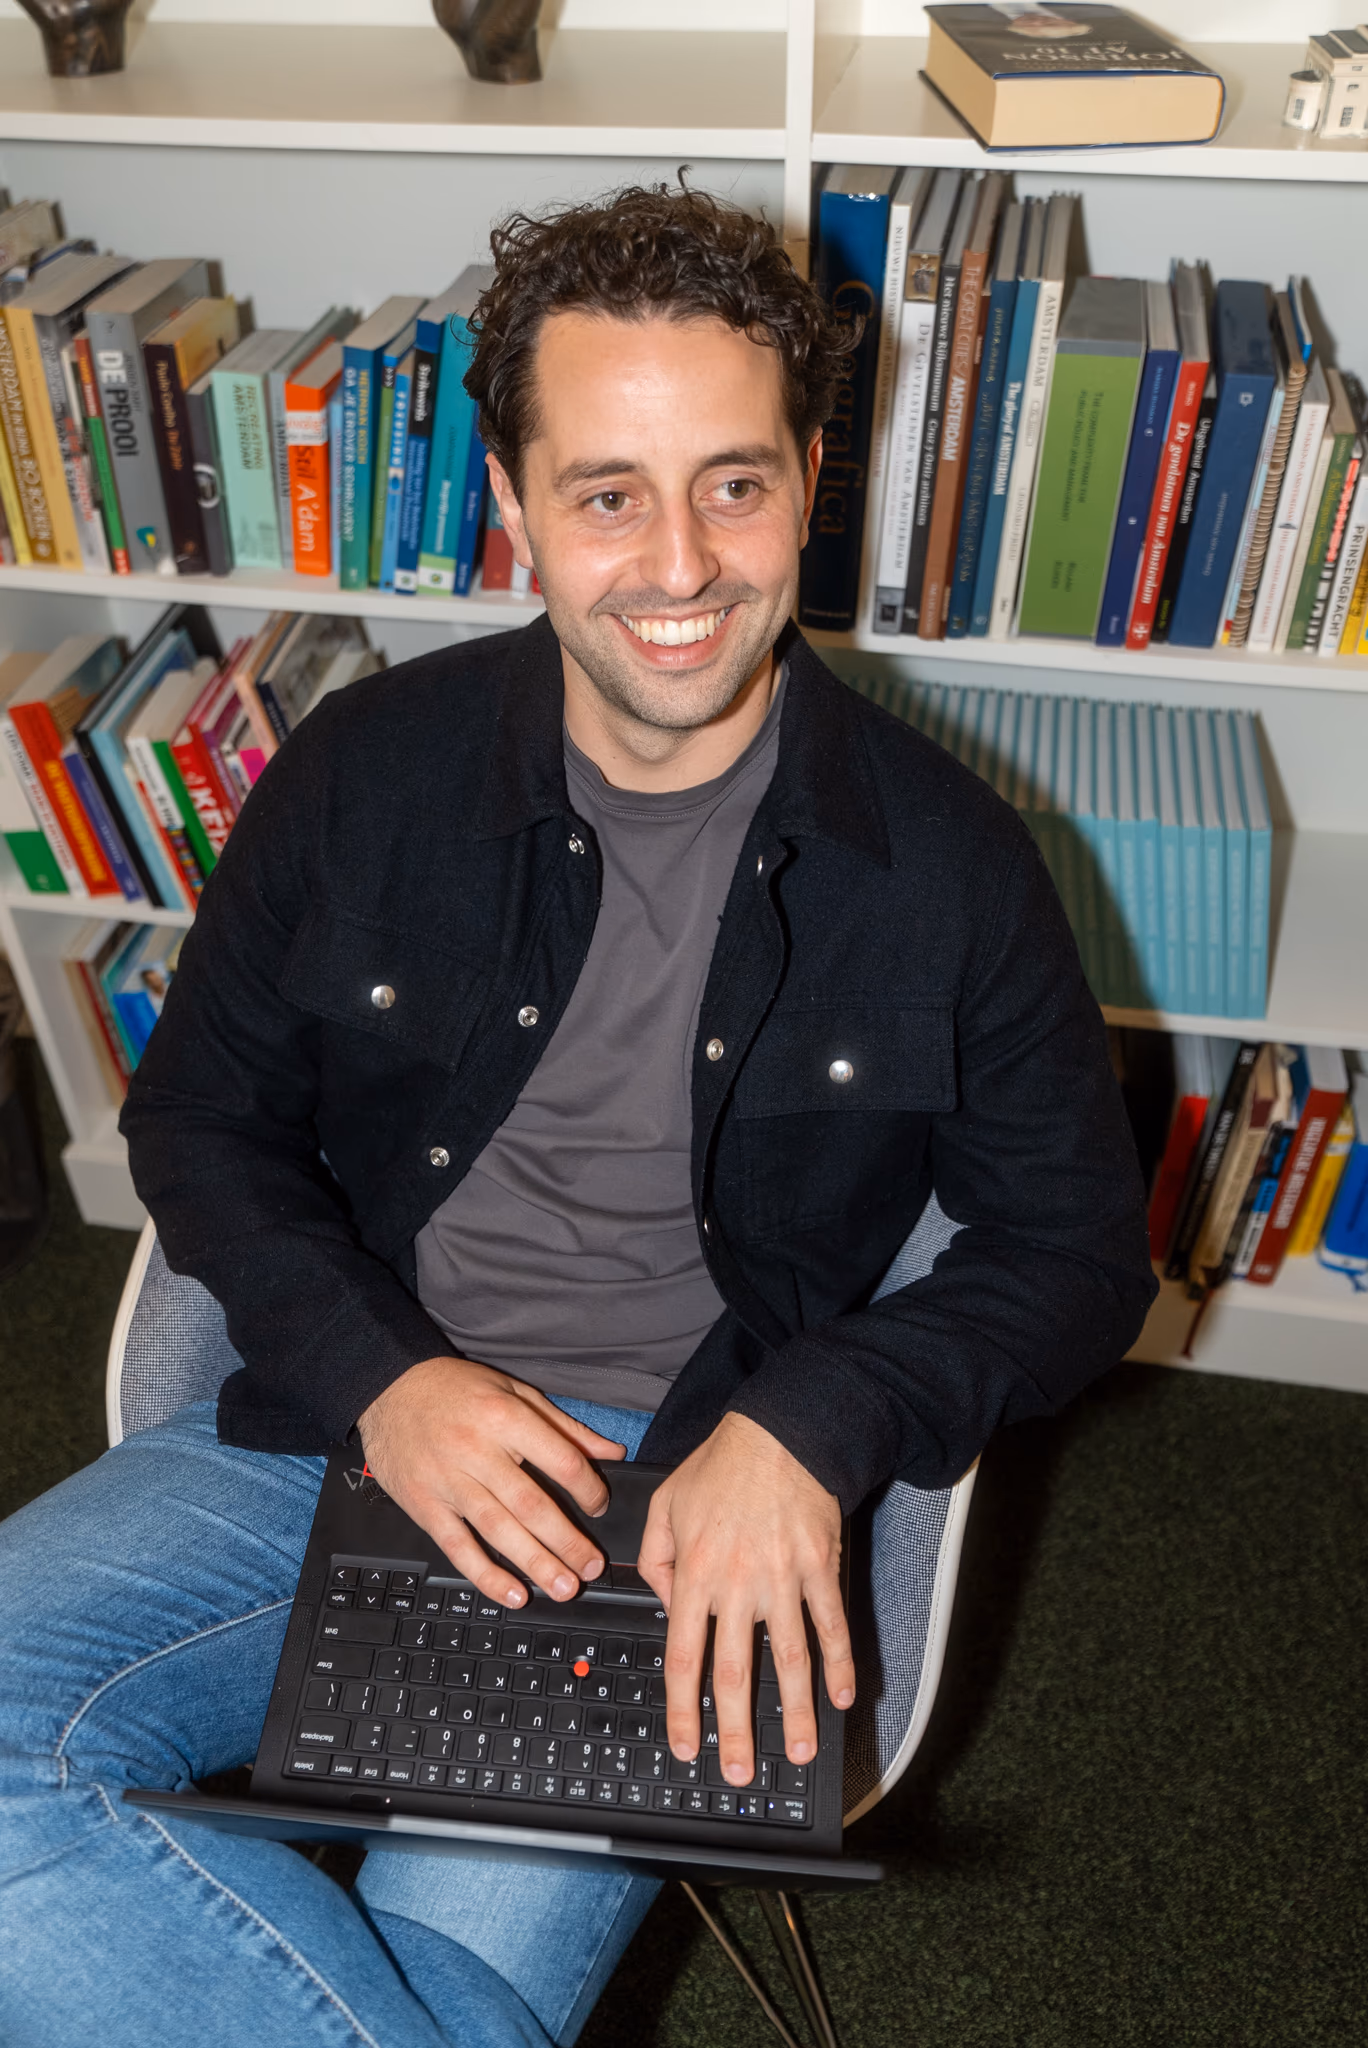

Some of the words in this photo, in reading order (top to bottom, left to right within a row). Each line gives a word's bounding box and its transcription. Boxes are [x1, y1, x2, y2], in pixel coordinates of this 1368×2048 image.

[1002, 50, 1183, 61] JOHNSON
[891, 225, 904, 274] NIEUWE
[964, 265, 981, 290] THE
[943, 275, 956, 298] Het
[959, 291, 977, 332] GREAT
[938, 299, 953, 339] nieuwe
[1033, 295, 1057, 387] AMSTERDAM
[97, 350, 127, 384] DE
[155, 360, 171, 391] Paulo
[929, 340, 948, 412] Rijksmuseum
[1008, 380, 1023, 398] The
[357, 369, 369, 427] HERMAN
[1092, 391, 1104, 407] THE
[160, 391, 177, 429] Coelho
[817, 280, 875, 534] Gografica
[105, 388, 139, 457] PROOI
[941, 376, 967, 462] AMSTERDAM
[232, 382, 253, 470] AMSTERDAM
[926, 418, 939, 443] Cruz
[1175, 421, 1192, 443] De
[343, 410, 356, 463] EROVER
[357, 429, 368, 465] KOCH
[1192, 417, 1213, 469] Uitgebreid
[922, 452, 935, 480] Ortiz
[993, 435, 1014, 496] AMSTERDAM
[1160, 443, 1184, 513] gevelstenen
[1061, 467, 1076, 522] MANAGEMENT
[1179, 469, 1200, 524] Amsterdam
[343, 464, 356, 542] SCHRIJVEN?
[916, 479, 932, 526] architects
[1156, 513, 1170, 538] van
[1141, 538, 1167, 604] Amsterdam
[1328, 525, 1366, 638] PRINSENGRACHT
[396, 1600, 410, 1608] PgUp
[427, 1603, 439, 1611] Ctrl
[325, 1627, 339, 1636] Shift
[517, 1644, 528, 1655] M
[552, 1647, 561, 1658] N
[586, 1646, 595, 1656] B
[620, 1654, 628, 1664] V
[654, 1657, 663, 1667] C
[317, 1661, 334, 1670] Enter
[463, 1674, 470, 1684] L
[496, 1677, 505, 1688] K
[530, 1680, 538, 1691] J
[564, 1684, 573, 1694] H
[599, 1686, 608, 1698] G
[634, 1690, 642, 1701] F
[703, 1697, 711, 1707] S
[429, 1707, 438, 1717] P
[463, 1709, 473, 1721] O
[533, 1716, 542, 1727] U
[568, 1720, 577, 1731] Y
[603, 1723, 612, 1734] T
[638, 1726, 647, 1738] R
[301, 1732, 335, 1743] Backspace
[443, 1730, 451, 1742] 0
[478, 1734, 486, 1745] 9
[707, 1733, 718, 1744] W
[513, 1737, 522, 1748] 8
[548, 1741, 556, 1752] 7
[584, 1744, 592, 1755] 6
[619, 1747, 627, 1759] 5
[655, 1751, 663, 1762] 4
[294, 1762, 315, 1771] Delete
[335, 1766, 353, 1775] Insert
[364, 1768, 379, 1777] End
[762, 1761, 768, 1773] 1
[390, 1771, 410, 1780] Home
[790, 1810, 804, 1820] Esc
